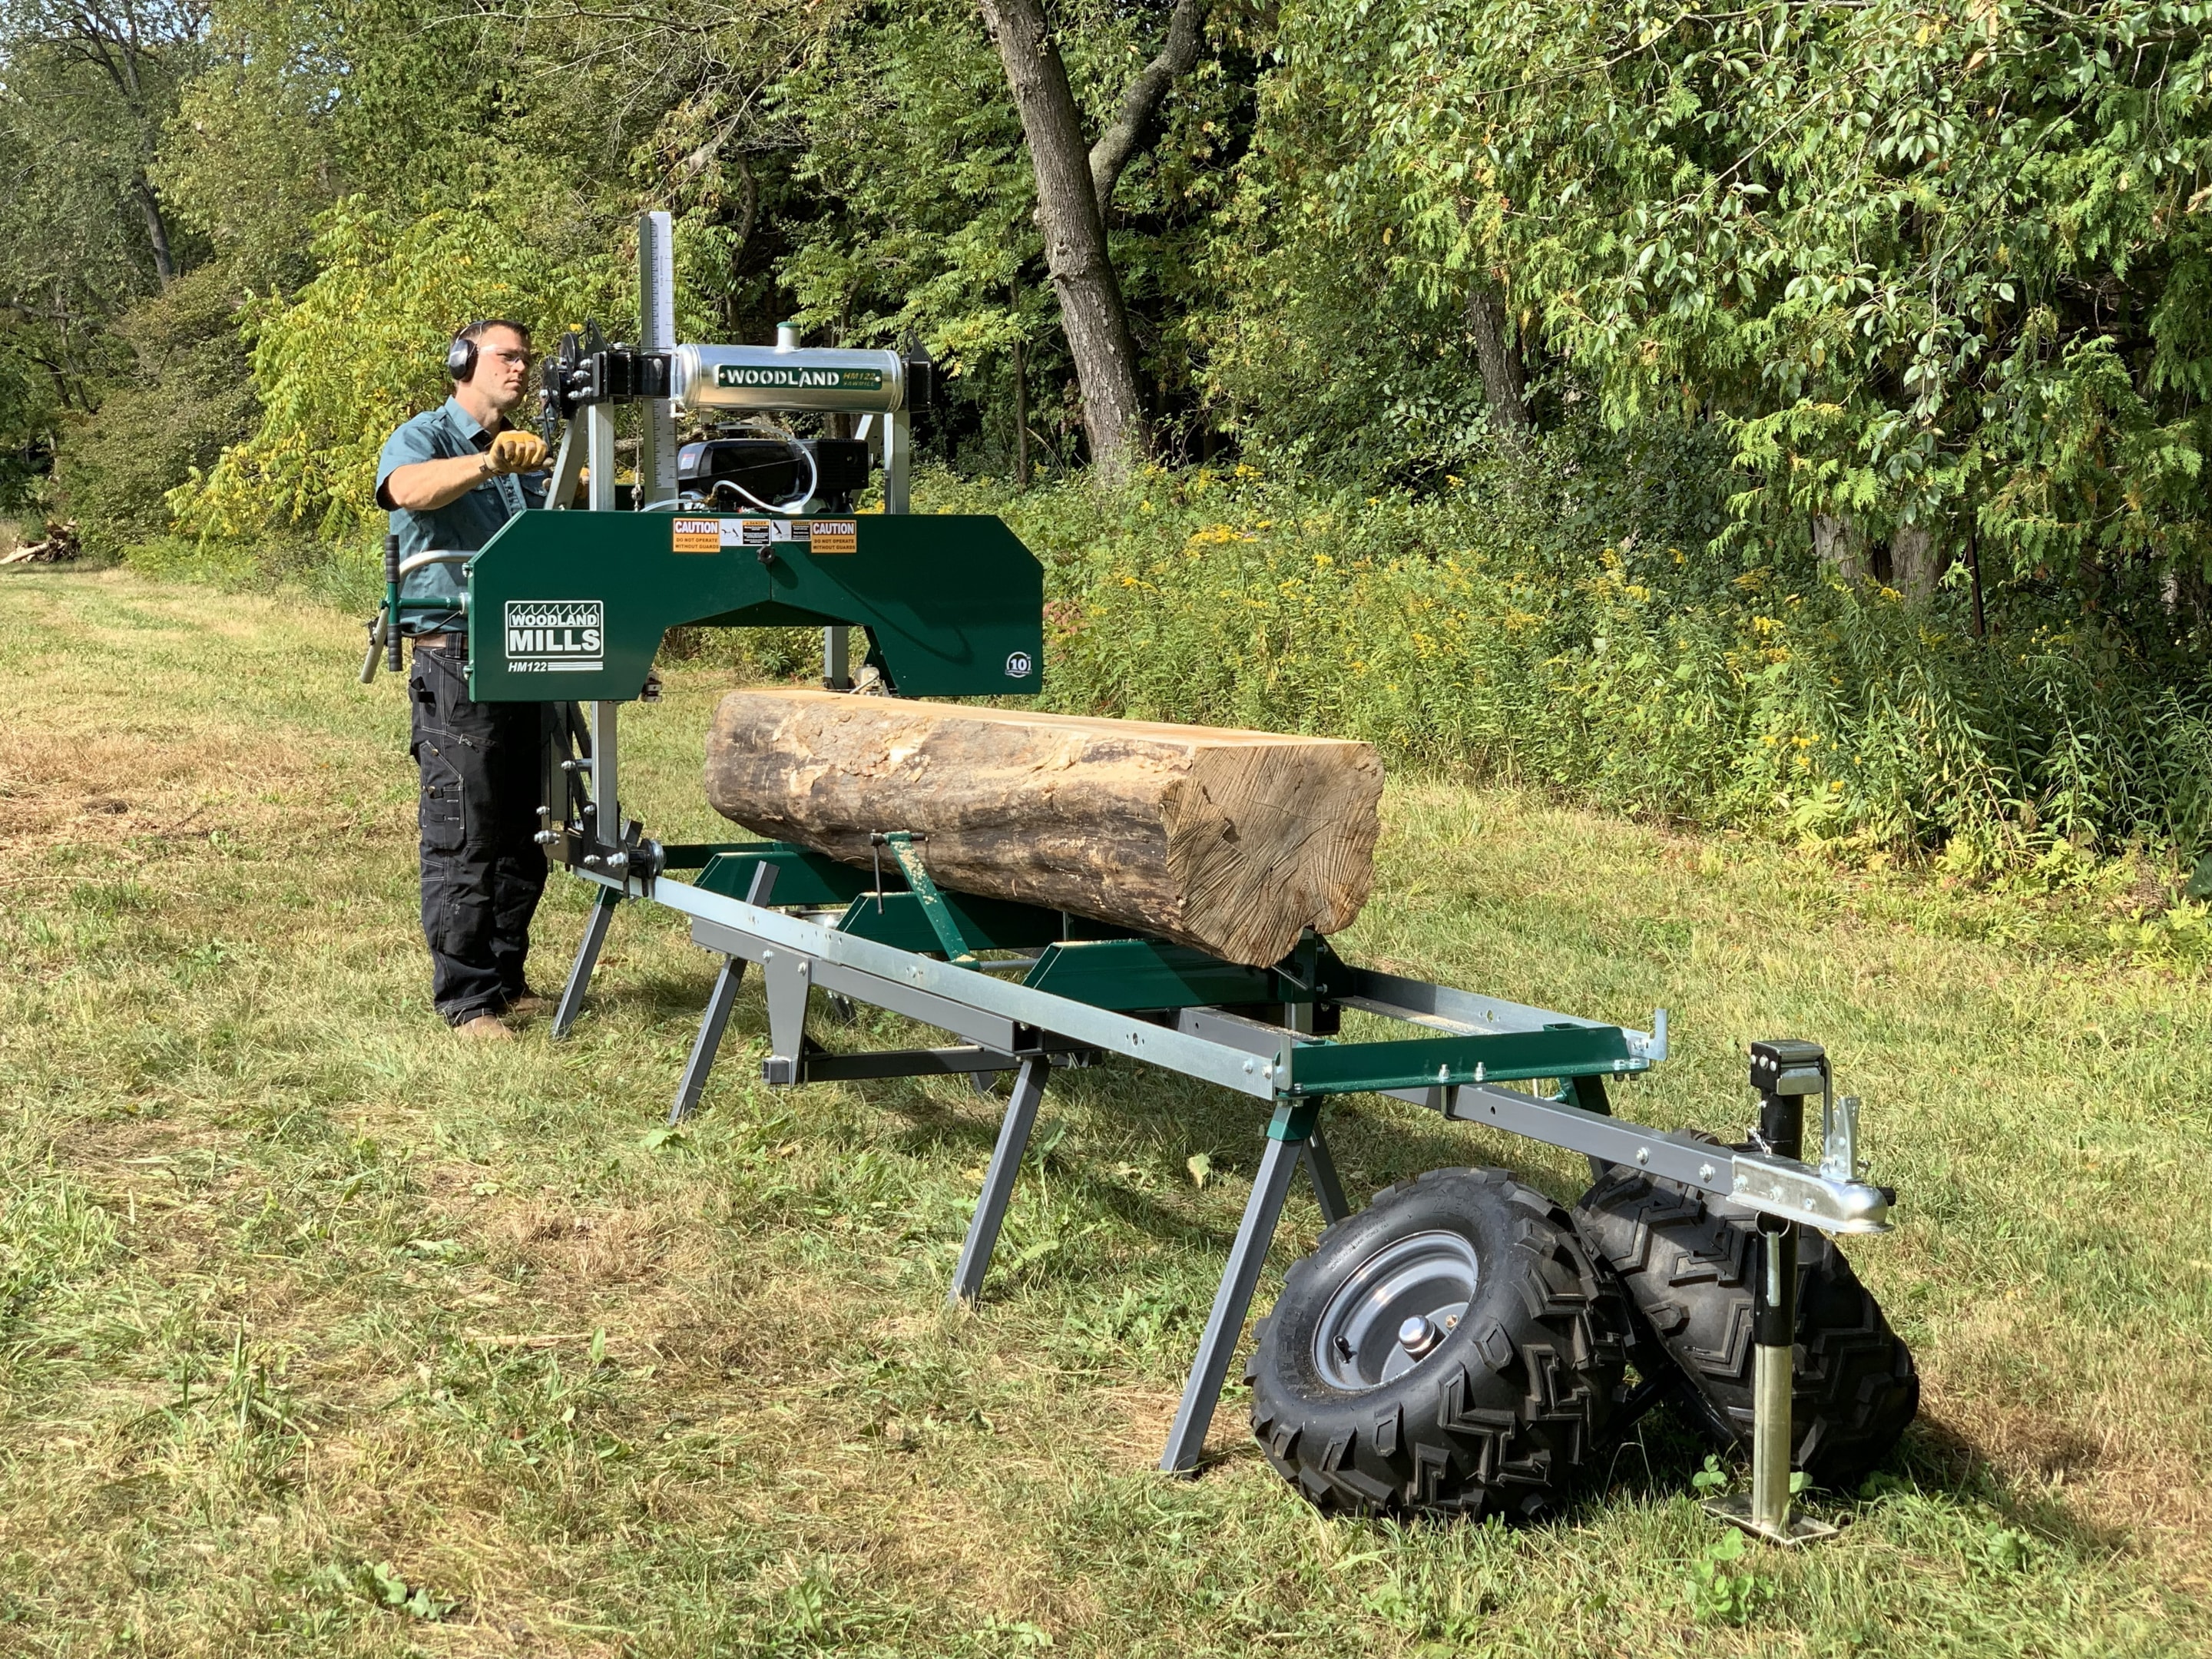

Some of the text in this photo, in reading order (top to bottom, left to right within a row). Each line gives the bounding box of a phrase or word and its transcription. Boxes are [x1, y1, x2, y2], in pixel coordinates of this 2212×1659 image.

[727, 369, 876, 386] WOODLAND HM122
[675, 521, 718, 534] CAUTION
[813, 522, 854, 535] CAUTION
[511, 614, 598, 626] WOODLAND
[509, 629, 601, 651] MILLS
[508, 662, 548, 672] HM122
[1010, 658, 1028, 671] 10
